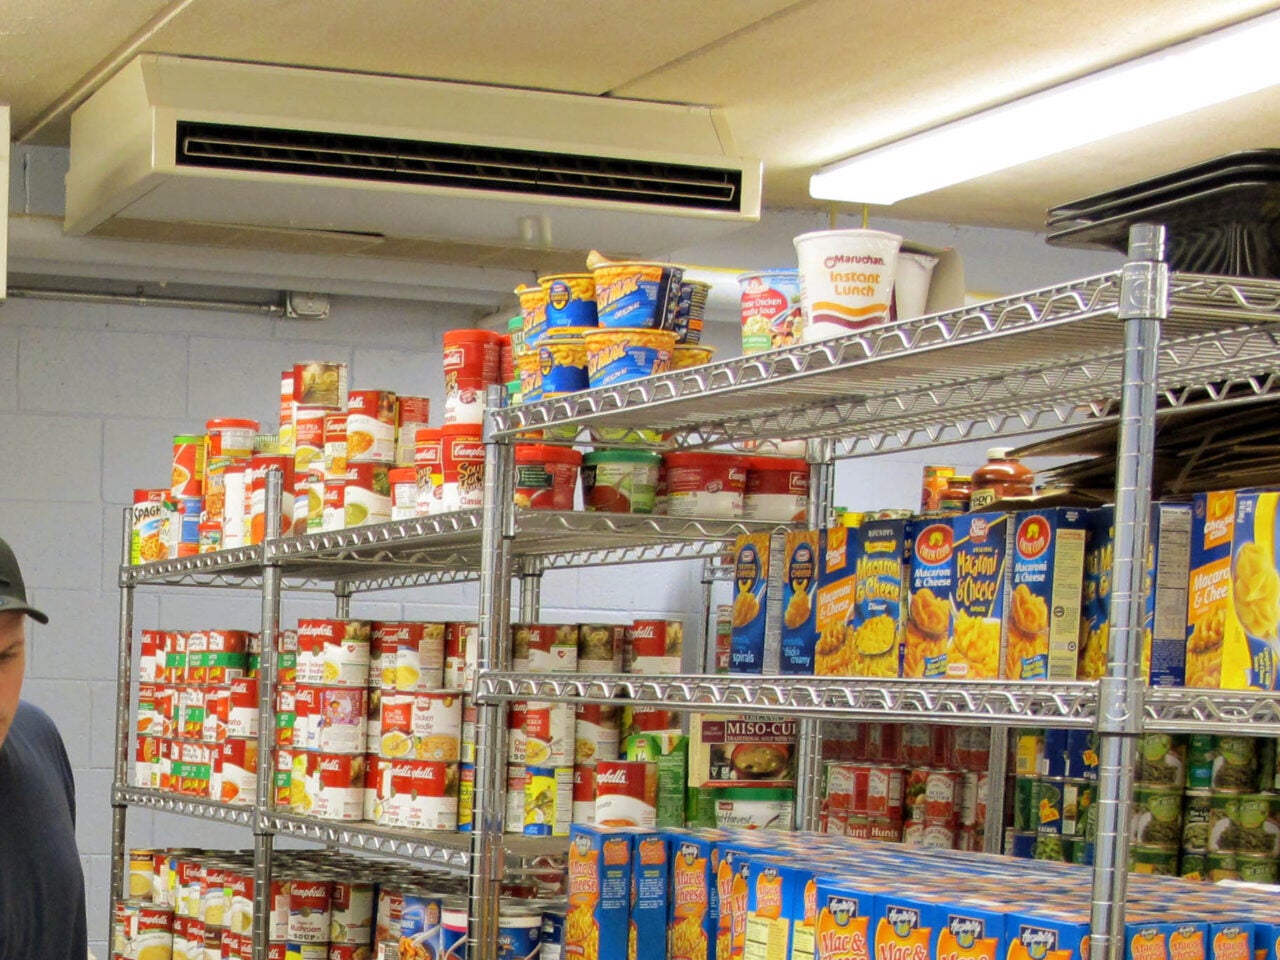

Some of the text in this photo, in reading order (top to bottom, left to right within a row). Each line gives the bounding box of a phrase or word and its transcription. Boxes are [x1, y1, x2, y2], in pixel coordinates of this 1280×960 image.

[830, 271, 880, 284] Instant
[834, 284, 875, 297] Lunch
[957, 550, 999, 577] Macaroni
[923, 577, 951, 588] Cheese
[1021, 572, 1046, 583] Cheese
[1193, 567, 1230, 590] Macaro
[963, 576, 996, 605] Cheese
[1204, 585, 1229, 605] Chee
[732, 650, 755, 665] spirals
[821, 931, 864, 954] Mac &
